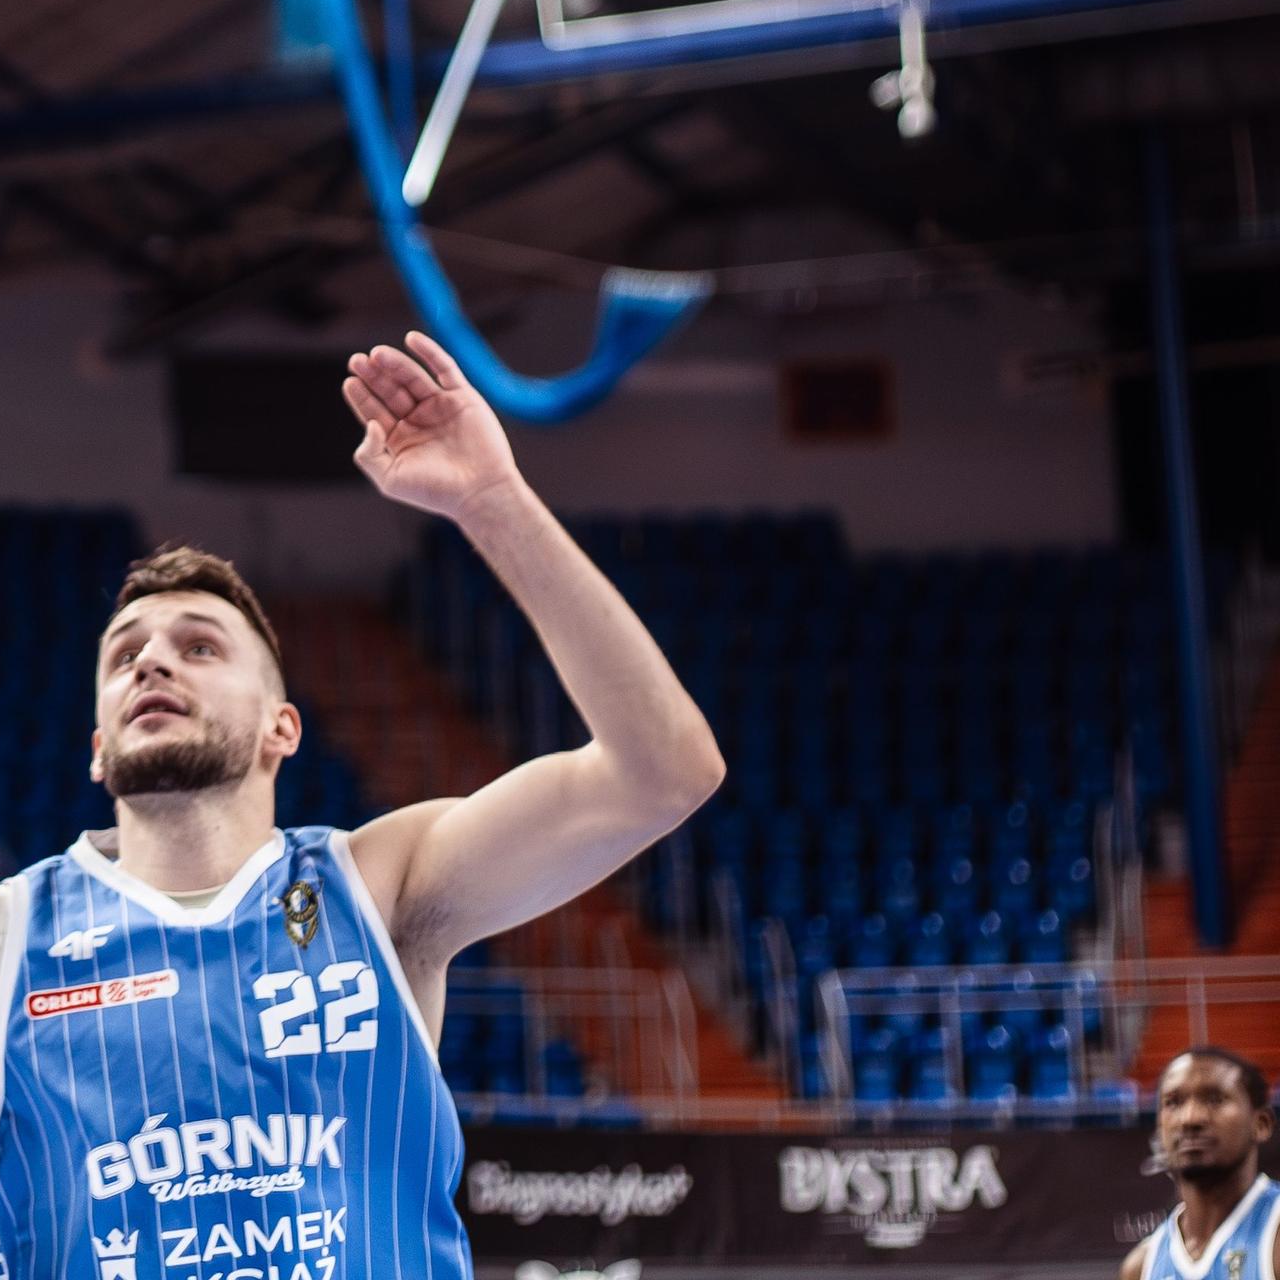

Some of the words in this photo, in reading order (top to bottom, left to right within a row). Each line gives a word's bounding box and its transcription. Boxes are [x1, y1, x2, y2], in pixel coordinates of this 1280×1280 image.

[47, 923, 116, 962] 4F
[30, 987, 98, 1013] ORLEN
[253, 960, 380, 1059] 22
[85, 1112, 348, 1201] GÓRNIK
[148, 1164, 307, 1204] Wałbrzych
[159, 1206, 348, 1268] ZAMEK
